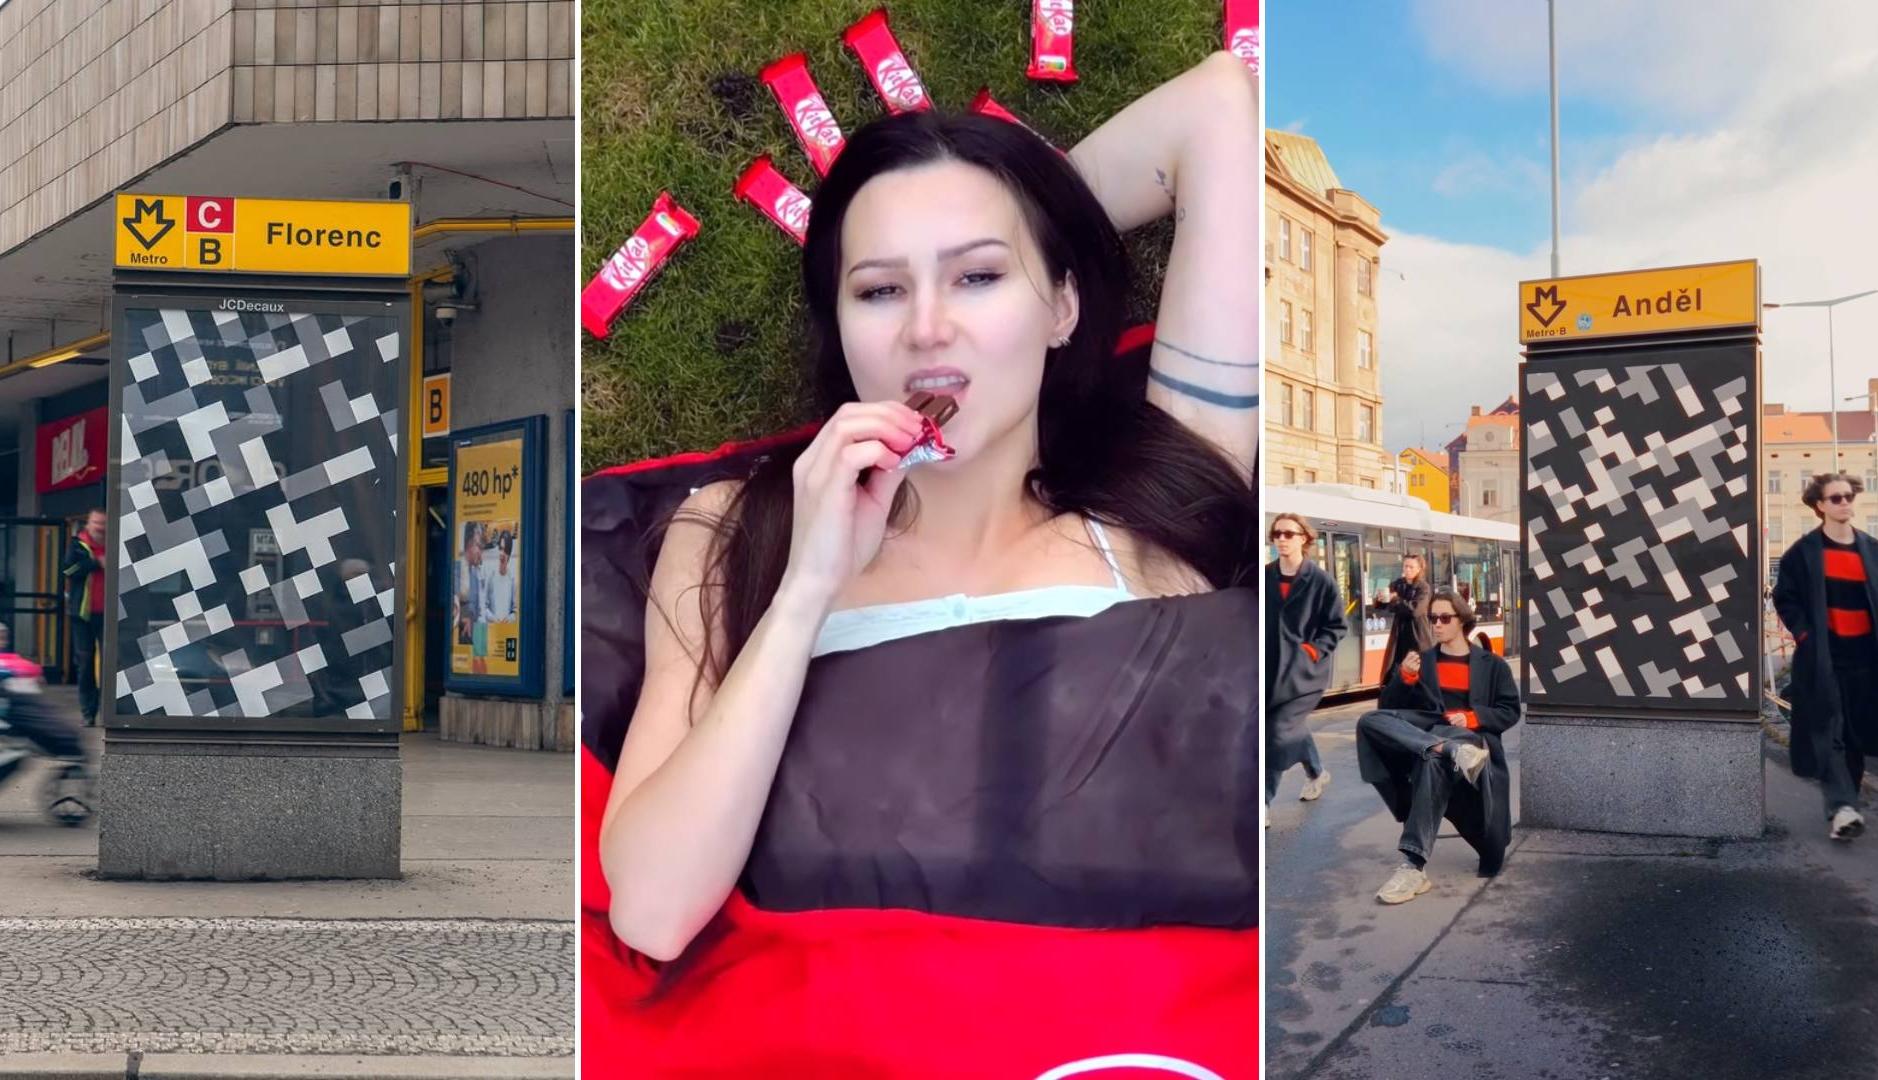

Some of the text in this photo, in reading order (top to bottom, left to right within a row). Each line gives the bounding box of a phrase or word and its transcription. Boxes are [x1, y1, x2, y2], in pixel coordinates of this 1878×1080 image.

[878, 62, 920, 105] KitKat
[796, 101, 840, 144] KitKat
[198, 201, 222, 229] C
[266, 221, 382, 249] Florenc
[130, 252, 169, 265] Metro
[199, 238, 222, 265] B
[611, 238, 647, 287] KitKat
[218, 298, 285, 313] JCDecaux
[1612, 288, 1701, 318] Anděl
[429, 388, 443, 424] B
[462, 469, 490, 497] 480
